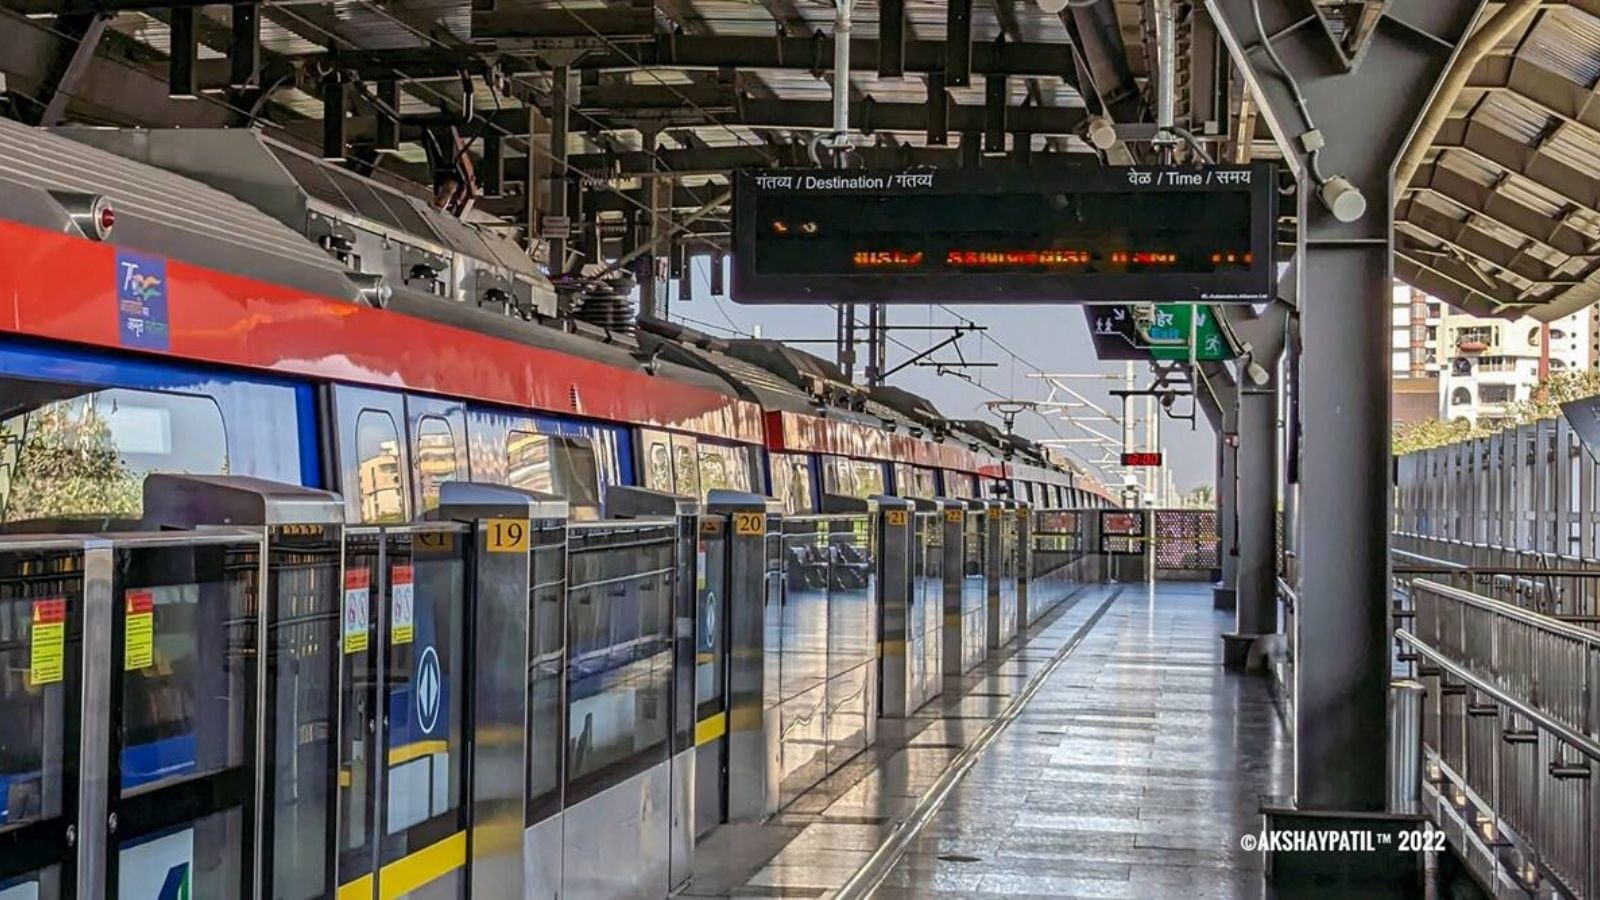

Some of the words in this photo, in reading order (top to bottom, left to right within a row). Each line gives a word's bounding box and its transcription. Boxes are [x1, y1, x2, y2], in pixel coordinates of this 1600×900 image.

[755, 172, 793, 190] गंतव्य
[805, 176, 883, 189] Destination
[1127, 167, 1152, 185] वेळ
[1166, 172, 1202, 185] Time
[1215, 171, 1251, 184] समय
[740, 515, 761, 531] 20
[891, 512, 905, 523] 21
[494, 523, 523, 548] 19
